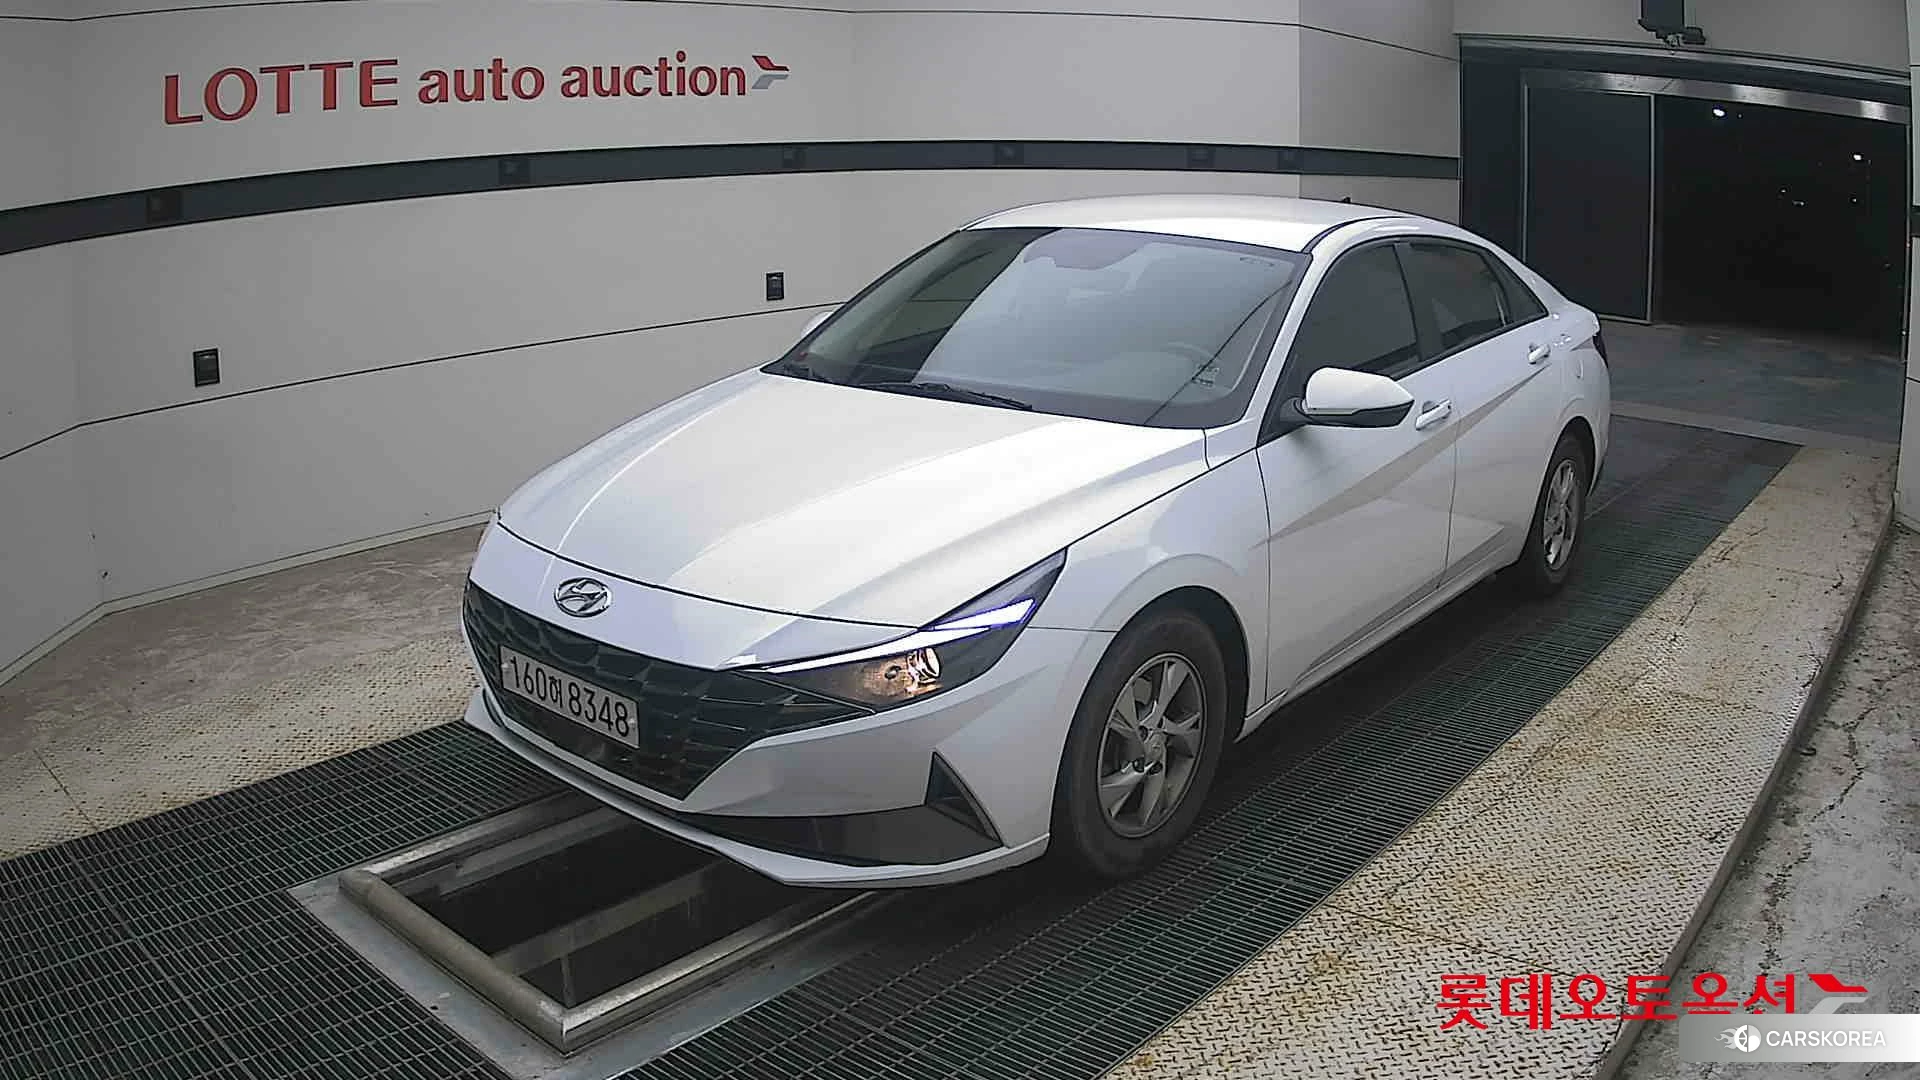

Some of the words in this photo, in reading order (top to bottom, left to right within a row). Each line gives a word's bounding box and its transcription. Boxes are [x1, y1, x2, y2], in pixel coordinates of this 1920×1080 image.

[163, 58, 400, 125] LOTTE
[417, 57, 545, 105] auto
[560, 50, 748, 97] auction
[510, 655, 563, 709] 160허
[568, 681, 630, 738] 8348
